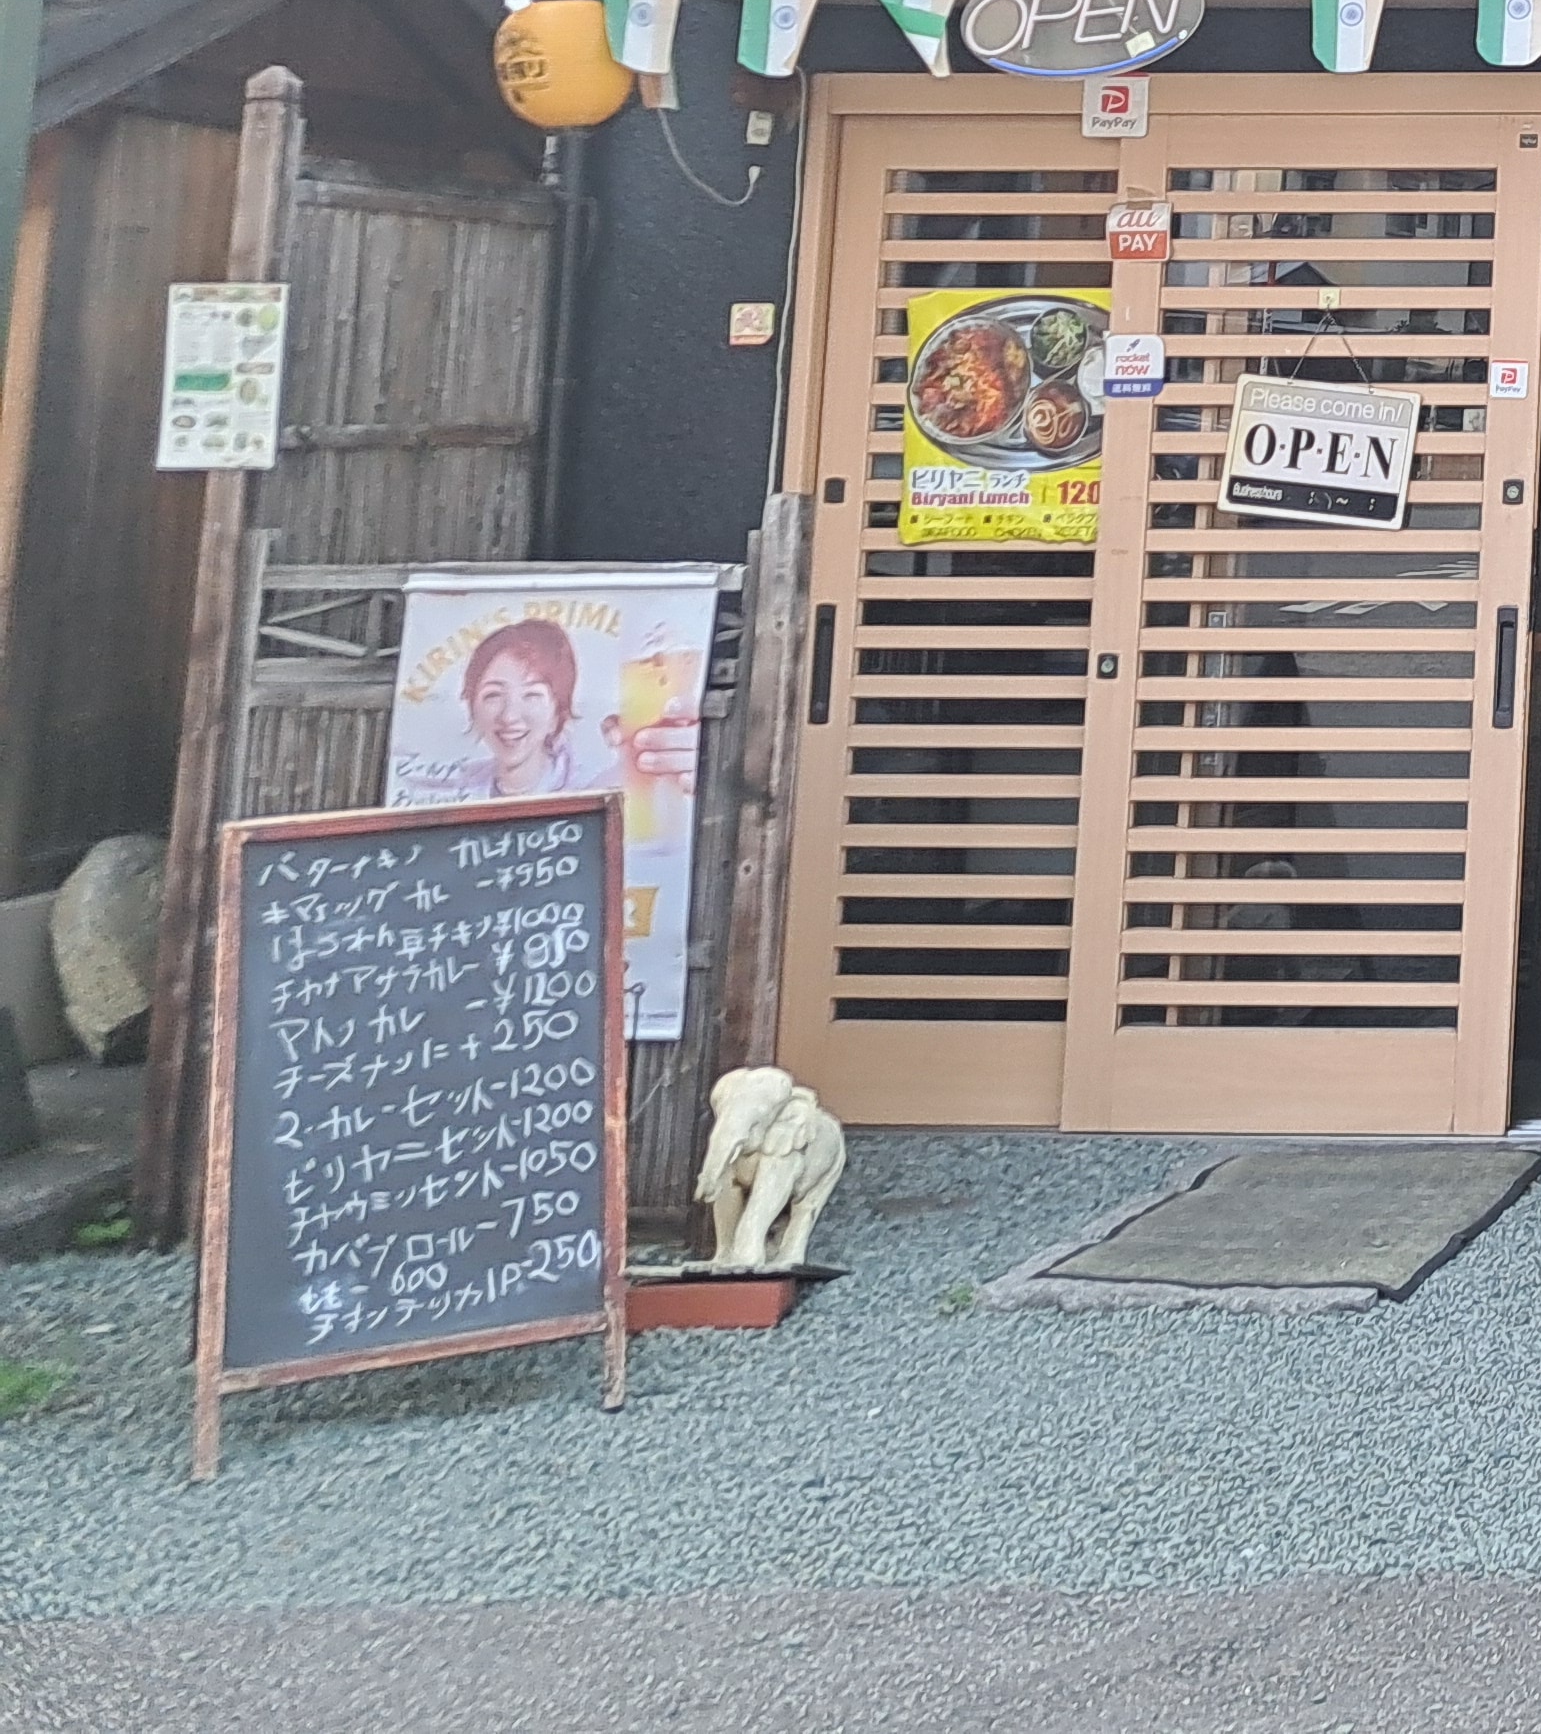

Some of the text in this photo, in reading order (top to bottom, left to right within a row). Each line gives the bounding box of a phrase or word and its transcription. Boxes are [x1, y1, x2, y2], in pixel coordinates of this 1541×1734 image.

[1091, 116, 1137, 130] PayPay
[1117, 232, 1159, 252] PAY
[1249, 387, 1316, 411] Please
[1320, 397, 1375, 419] come
[911, 491, 1030, 507] Biryani Lunch
